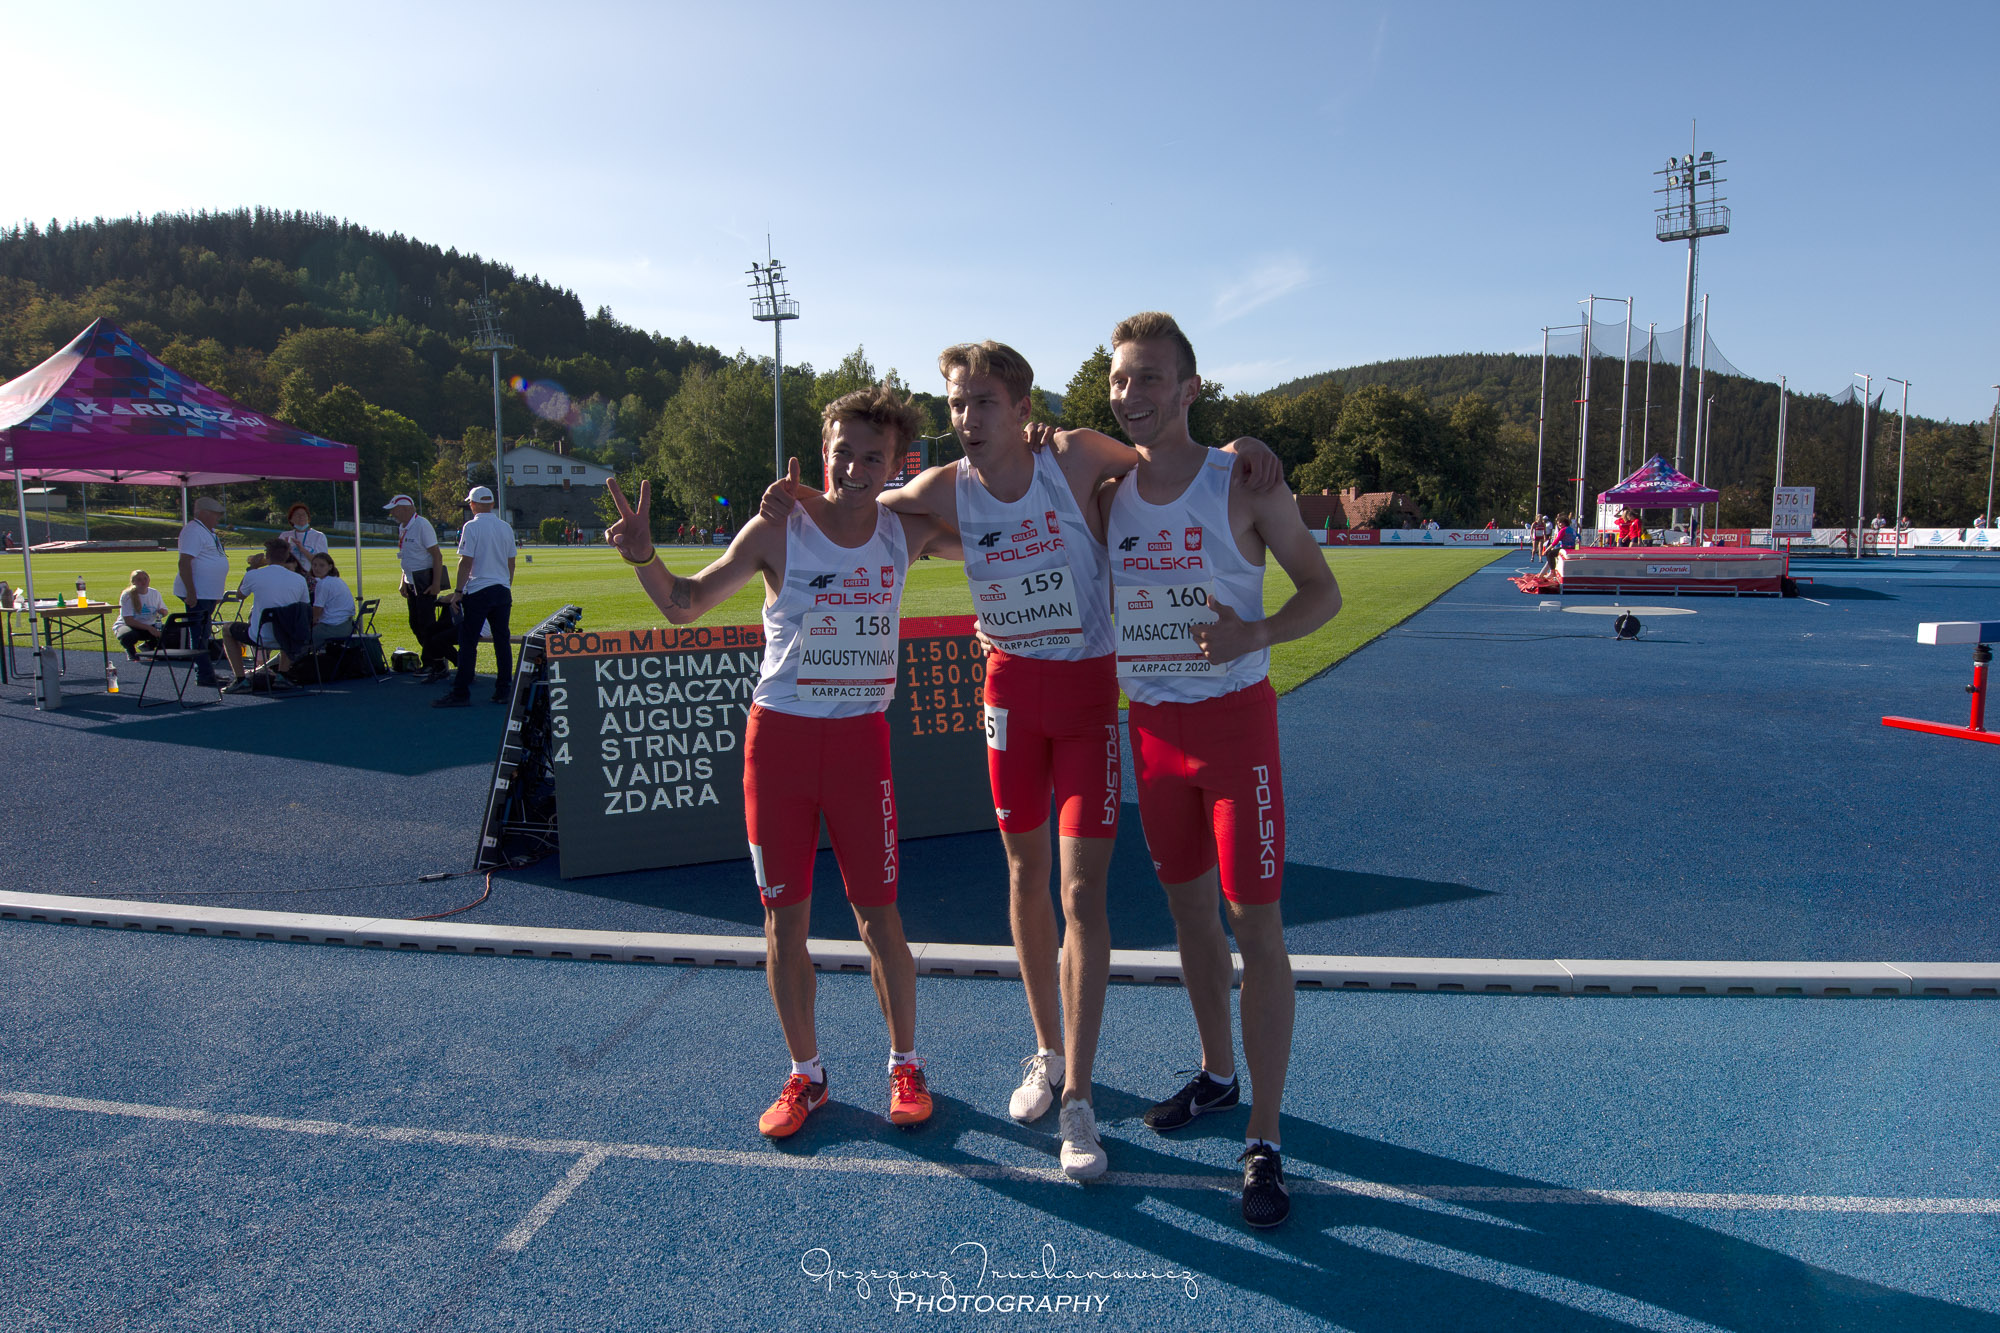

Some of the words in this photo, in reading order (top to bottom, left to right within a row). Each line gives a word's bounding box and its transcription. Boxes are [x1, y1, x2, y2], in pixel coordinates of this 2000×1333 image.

[978, 532, 1002, 547] 4F
[1012, 530, 1037, 542] ORLEN
[1119, 536, 1140, 551] 4F
[1865, 533, 1906, 544] ORLEN
[986, 538, 1065, 564] POLSKA
[1123, 556, 1203, 571] POLSKA
[809, 574, 836, 588] 4F
[1021, 571, 1063, 596] 159
[815, 592, 892, 605] POLSKA
[980, 593, 1005, 601] ORLEN
[1167, 587, 1208, 607] 160
[982, 602, 1072, 626] KUCHMAN
[855, 616, 890, 636] 158
[550, 632, 621, 655] 800m
[629, 630, 654, 650] M
[1048, 636, 1070, 644] 2020
[550, 661, 566, 683] 1
[595, 652, 760, 682] KUCHMAN
[906, 640, 981, 663] 1:50.0
[802, 650, 895, 665] AUGUSTYNIAK
[1132, 663, 1182, 672] KARPACZ
[1185, 662, 1210, 672] 2020
[550, 688, 568, 710] 2
[908, 663, 984, 687] 1:50.0
[812, 687, 861, 696] KARPACZ
[864, 687, 885, 696] 2020
[552, 715, 570, 737] 3
[988, 716, 995, 738] 5
[555, 742, 572, 764] 4
[601, 730, 736, 761] STRNAD
[602, 758, 713, 788] VAIDIS
[1102, 724, 1118, 825] POLSKA
[604, 783, 719, 814] ZDARA
[880, 779, 895, 883] POLSKA
[1253, 765, 1275, 879] POLSKA
[761, 884, 786, 898] 4F
